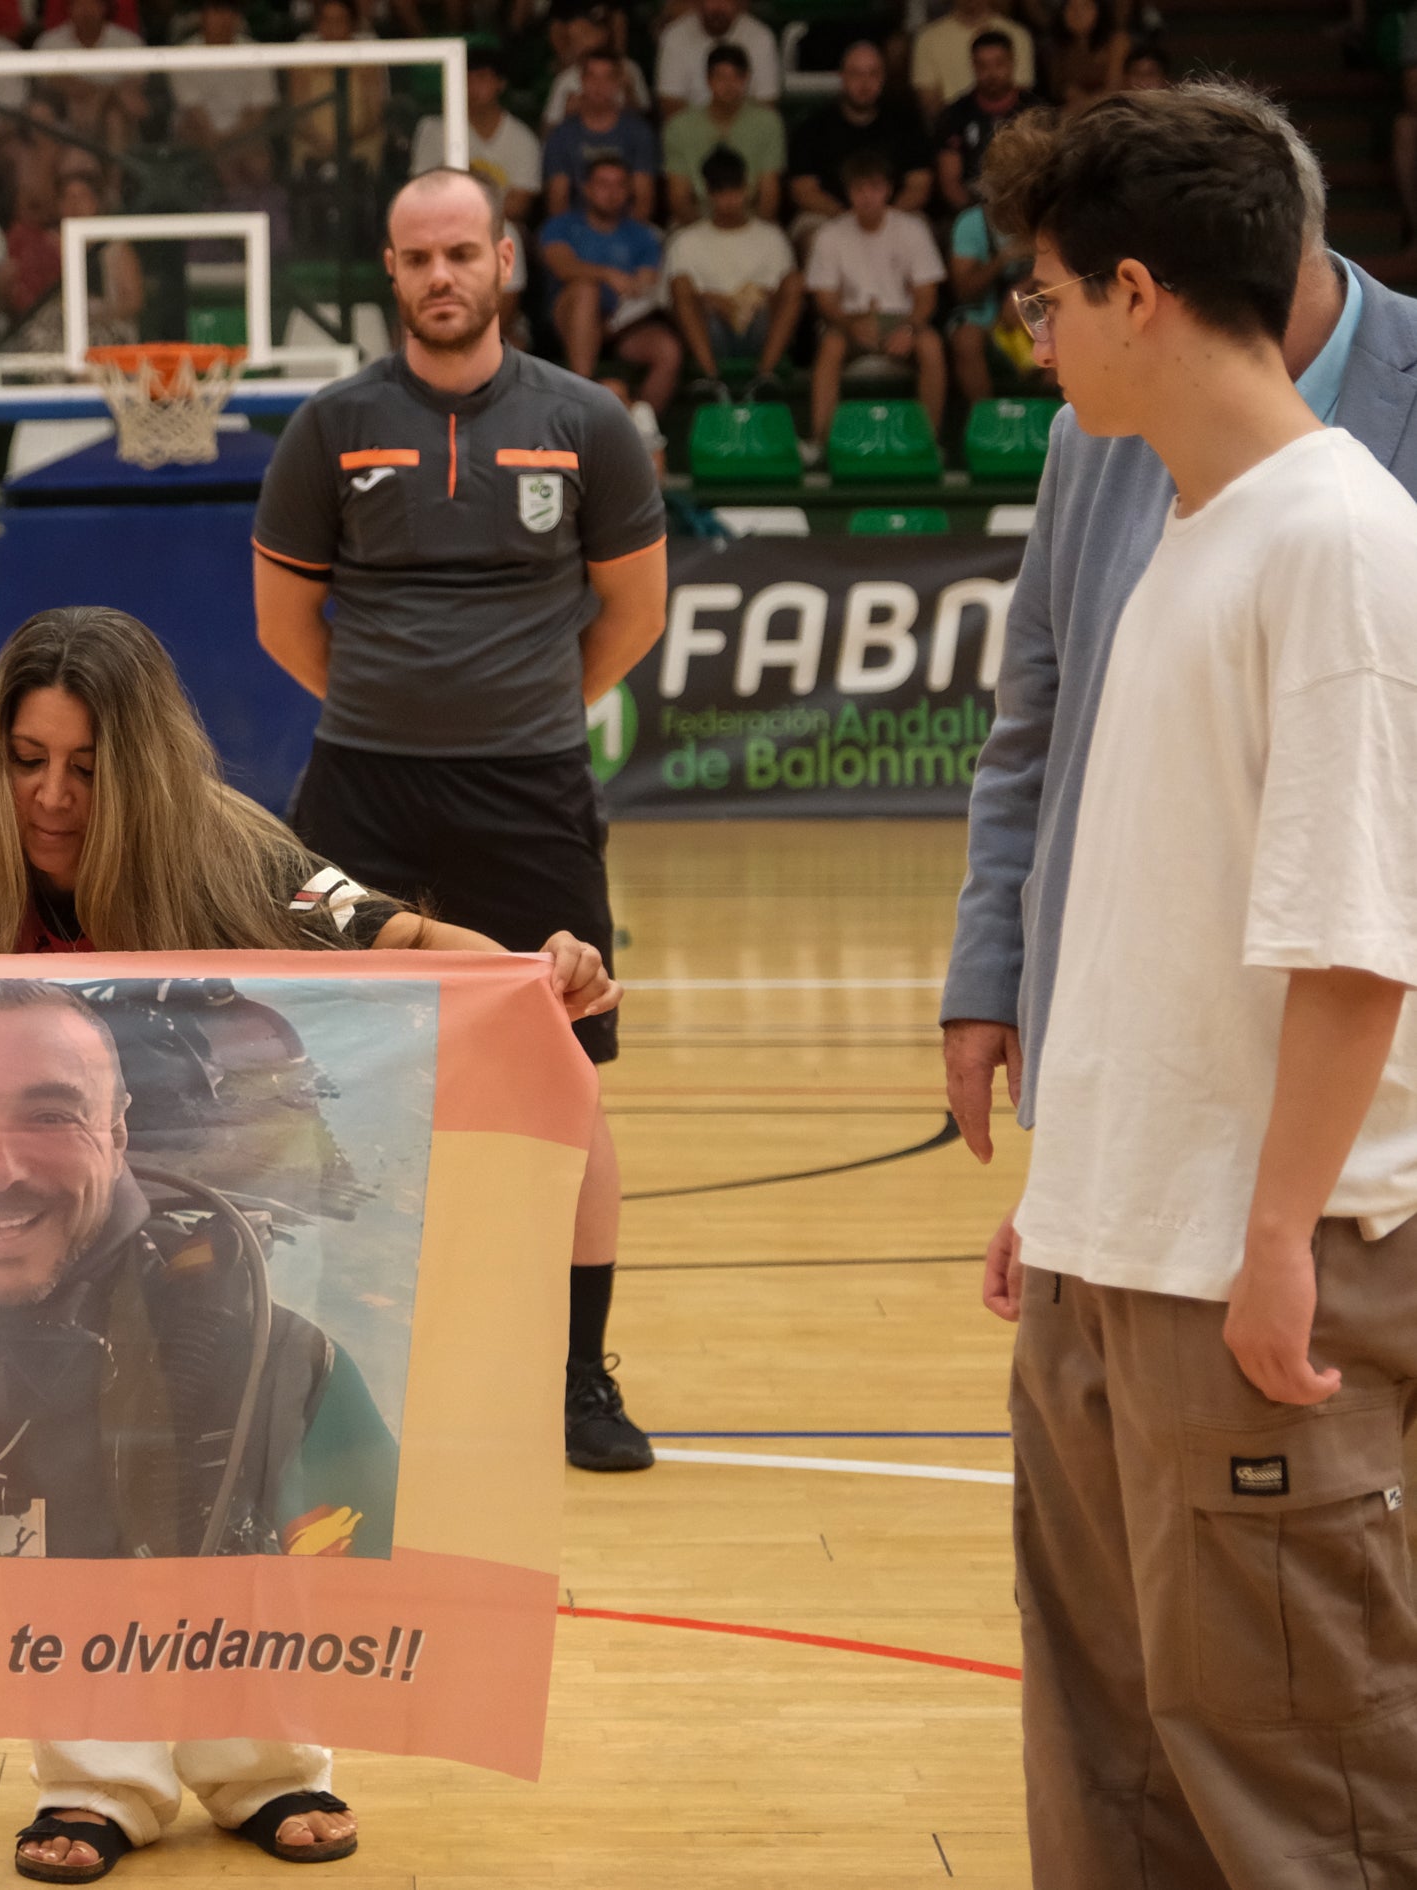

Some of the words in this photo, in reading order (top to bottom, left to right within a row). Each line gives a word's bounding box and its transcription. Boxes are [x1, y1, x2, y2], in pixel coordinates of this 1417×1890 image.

[662, 735, 730, 790] de
[8, 1623, 65, 1675] te
[81, 1616, 426, 1684] olvidamos!!
